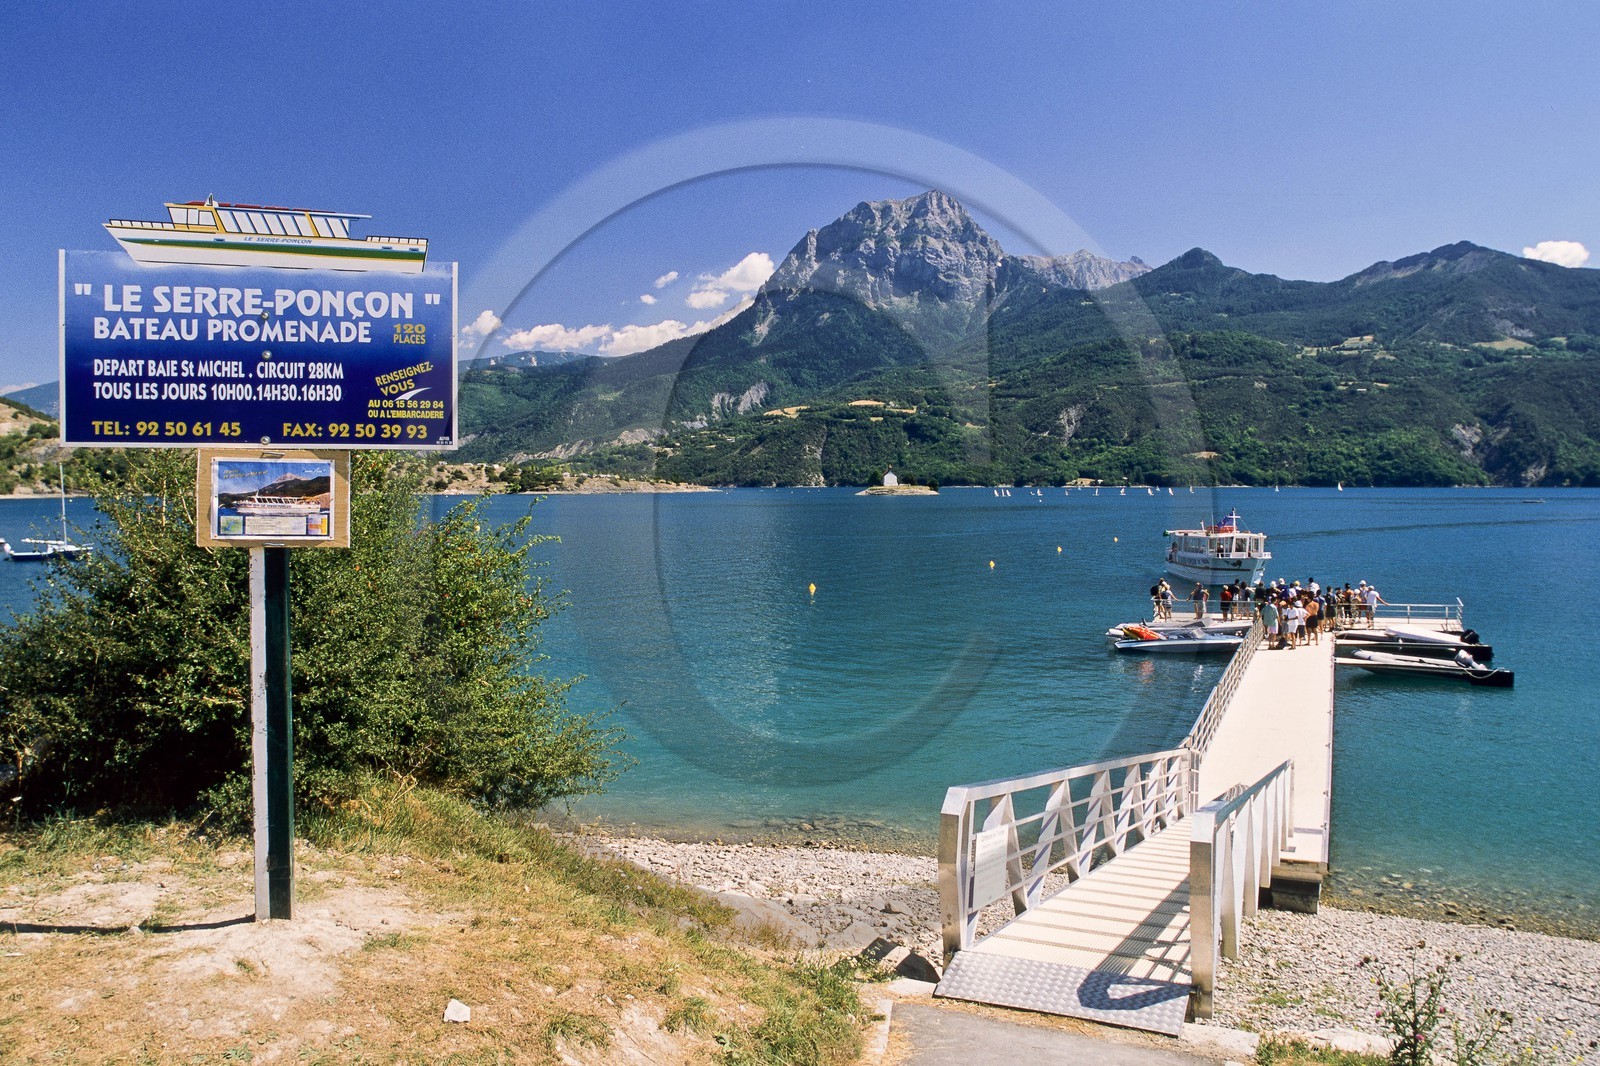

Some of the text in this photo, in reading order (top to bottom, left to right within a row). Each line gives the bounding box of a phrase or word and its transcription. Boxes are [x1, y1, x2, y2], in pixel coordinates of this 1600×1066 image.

[104, 284, 142, 312] LE
[153, 287, 413, 319] SERRE-PONÇON
[94, 317, 371, 343] BATEAU PROMENADE
[394, 324, 425, 334] 120
[393, 334, 426, 345] PLACES
[94, 360, 144, 377] DEPART
[148, 360, 178, 377] BAIE
[181, 362, 194, 378] St
[198, 362, 245, 378] MICHEL
[257, 362, 305, 379] CIRCUIT
[309, 363, 343, 380] 28KM
[375, 361, 433, 387] RENSEIGNEZ-
[94, 382, 131, 399] TOUS
[135, 383, 158, 400] LES
[162, 383, 206, 400] JOURS
[380, 380, 415, 396] VOUS
[368, 400, 380, 408] AU
[407, 400, 418, 409] 56
[420, 400, 430, 409] 29
[368, 409, 443, 418] OU A L'EMBARCADERE
[92, 420, 240, 436] TEL: 92 50 61 45
[283, 422, 323, 437] FAX:
[329, 423, 349, 437] 92
[355, 424, 376, 437] 50
[381, 424, 401, 438] 39
[408, 425, 427, 439] 93
